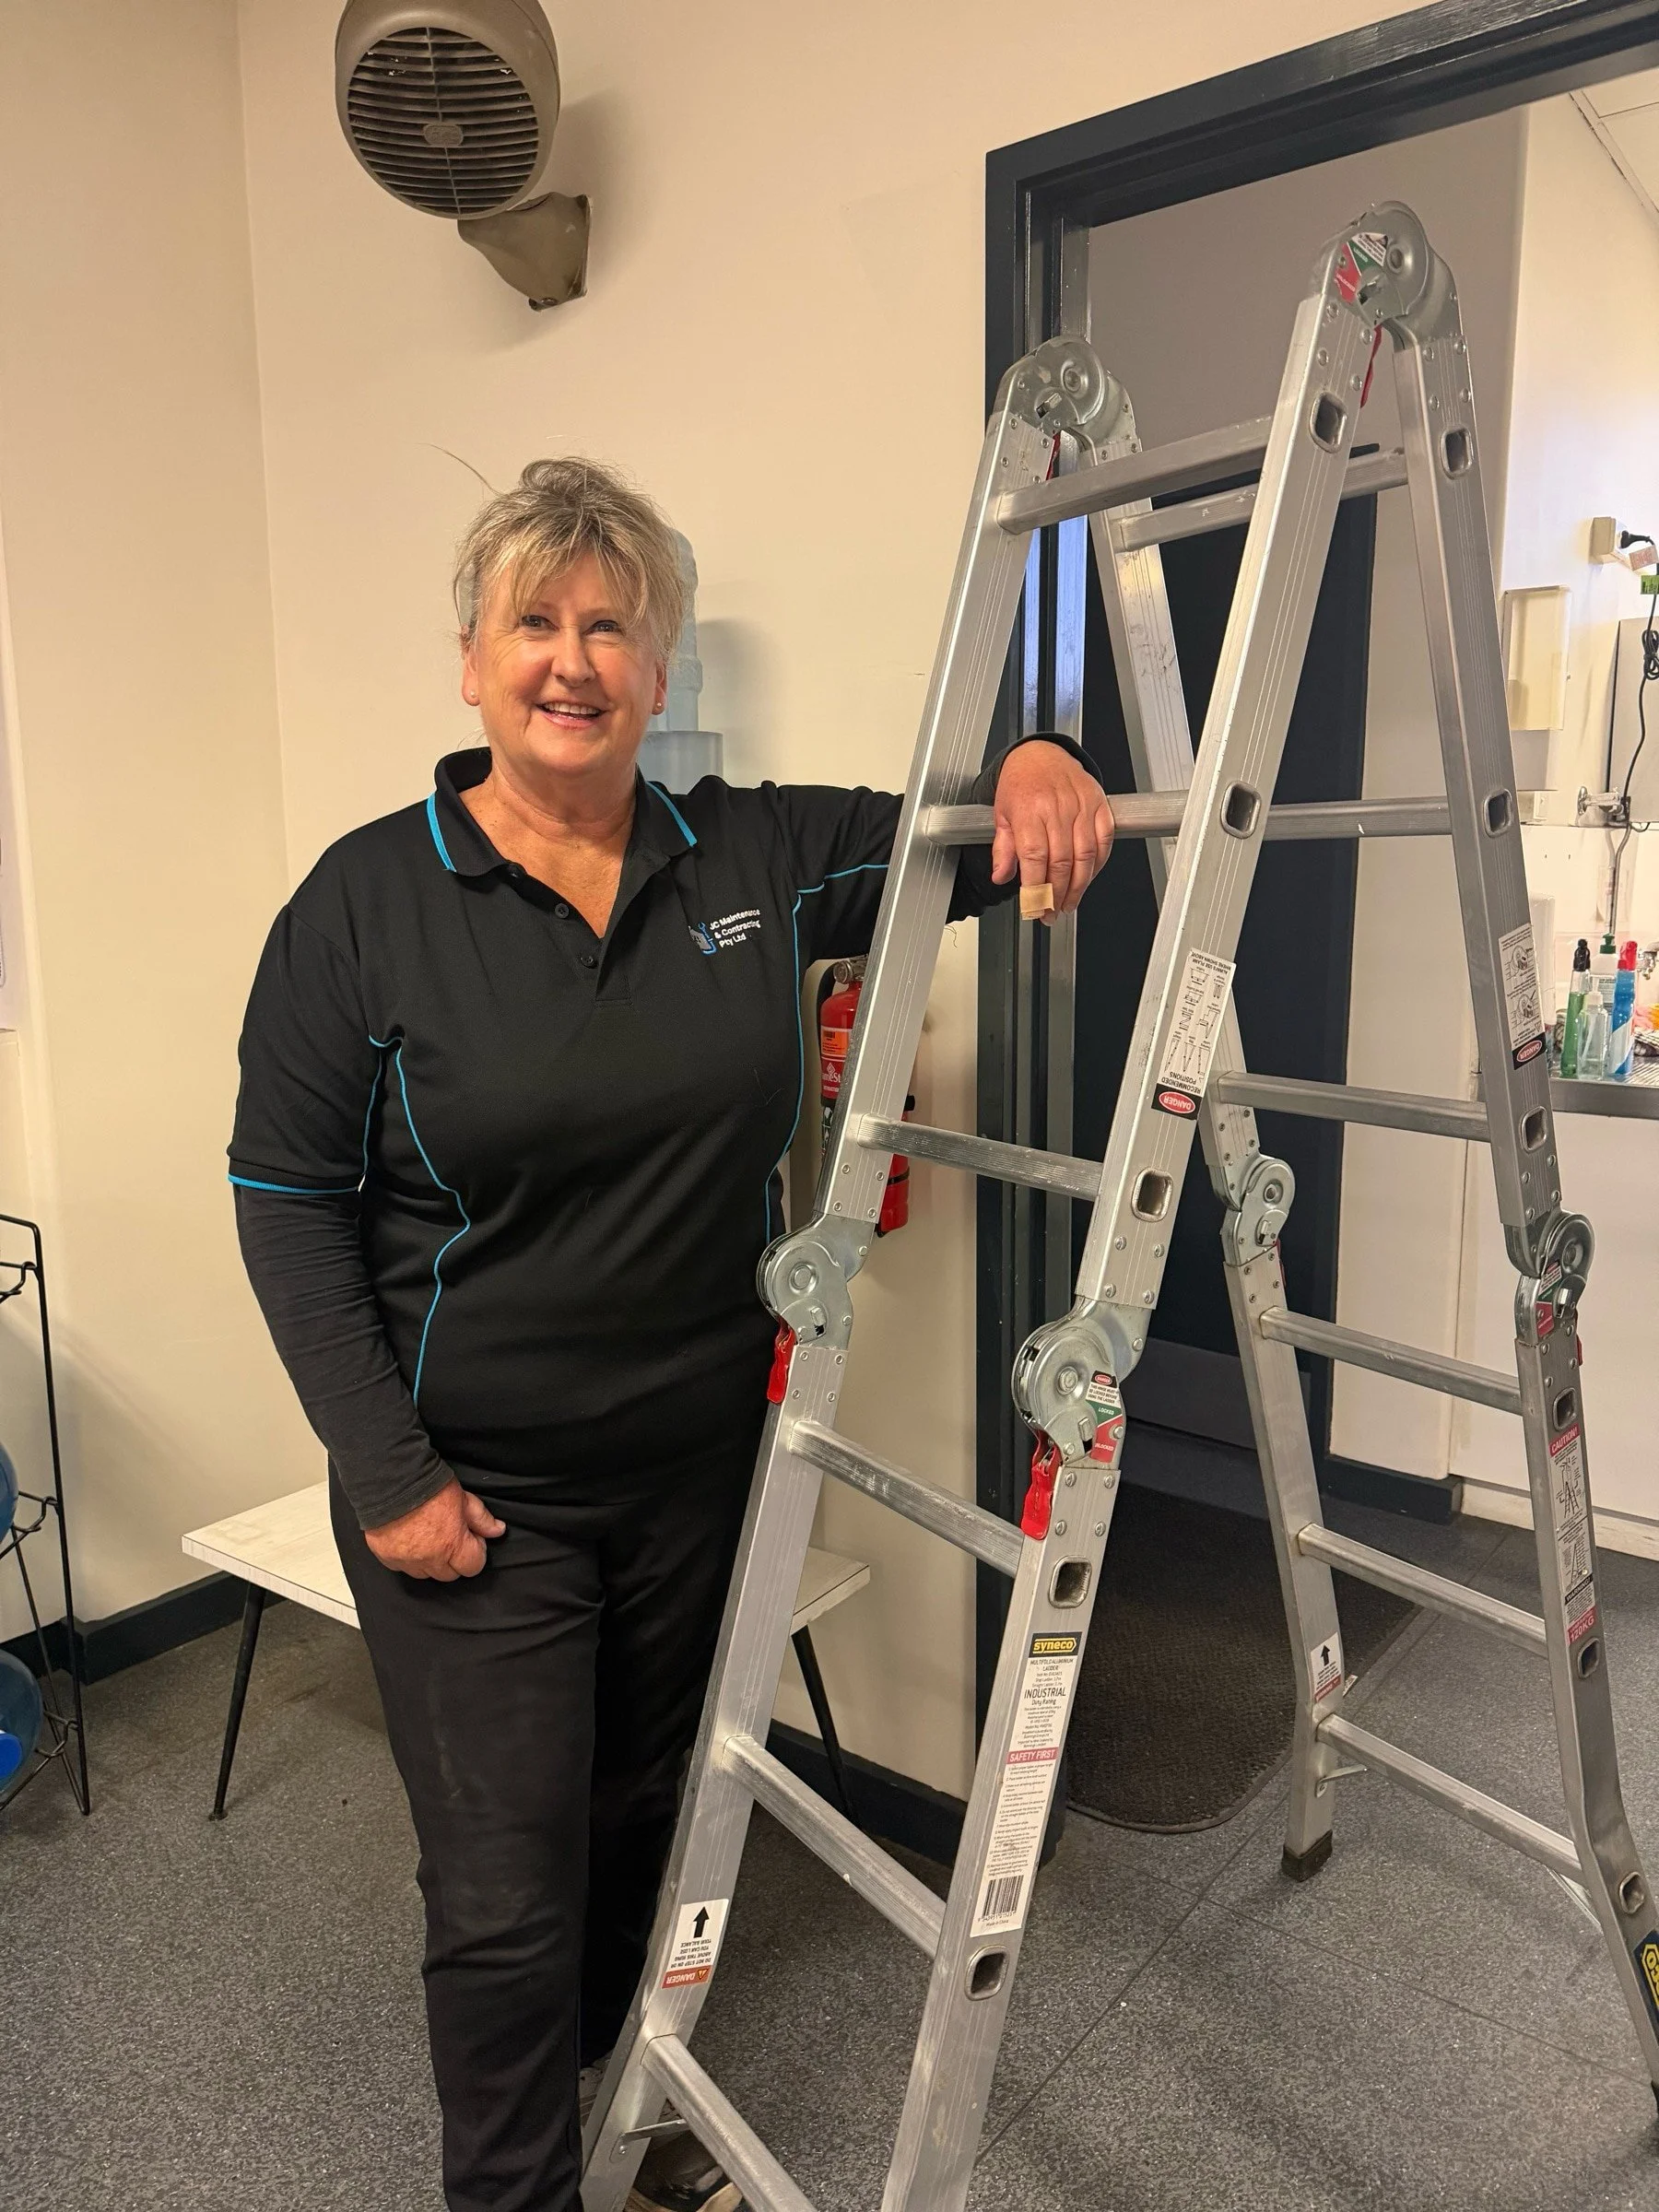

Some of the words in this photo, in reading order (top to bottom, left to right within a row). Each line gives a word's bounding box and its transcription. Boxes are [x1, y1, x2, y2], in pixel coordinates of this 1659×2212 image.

[710, 921, 720, 931] JC
[719, 909, 761, 926] Maintenance
[714, 931, 722, 939] &
[721, 920, 761, 936] Contracting
[718, 938, 734, 948] Pty
[733, 932, 747, 943] Ltd
[1161, 1077, 1202, 1094] RECOMMENDED
[1170, 1071, 1197, 1085] POSITIONS
[1163, 1095, 1192, 1111] DANGER
[1098, 1406, 1114, 1416] LOCKED
[1551, 1427, 1577, 1453] CAUTION!
[1570, 1616, 1594, 1641] 120KG
[1033, 1641, 1074, 1653] syneco
[1024, 1687, 1066, 1700] INDUSTRIAL
[1009, 1751, 1036, 1762] SAFETY
[1036, 1749, 1056, 1759] FIRST
[665, 1972, 696, 1984] DANGER
